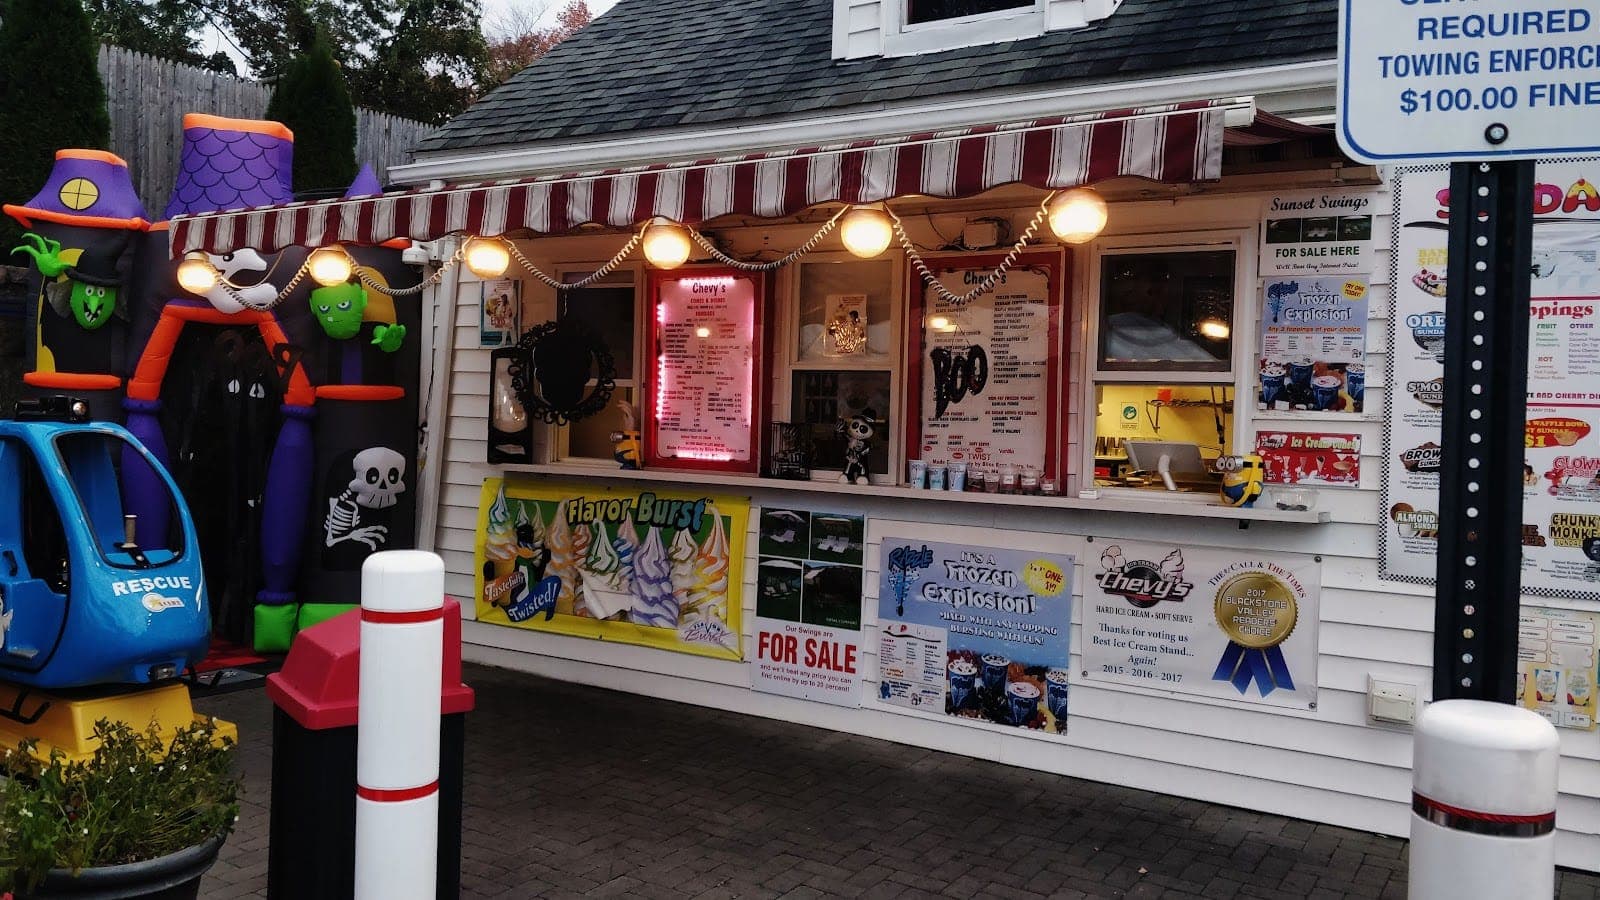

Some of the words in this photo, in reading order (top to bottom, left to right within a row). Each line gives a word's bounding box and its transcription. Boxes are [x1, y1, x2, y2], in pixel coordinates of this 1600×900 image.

[1417, 9, 1591, 41] REQUIRED
[1378, 50, 1480, 79] TOWING
[1400, 88, 1518, 116] $100.00
[1528, 82, 1600, 107] FINE
[1271, 197, 1315, 212] Sunset
[1320, 195, 1368, 211] Swings
[1275, 248, 1297, 258] FOR
[1300, 247, 1327, 257] SALE
[1330, 246, 1360, 256] HERE
[692, 282, 726, 296] Chevy's
[1298, 292, 1343, 305] Frozen
[1285, 307, 1353, 322] Explosion!
[1290, 436, 1303, 448] Ice
[568, 496, 633, 526] Flavor
[637, 491, 707, 532] Burst
[1396, 511, 1435, 524] ALMOND
[961, 551, 984, 564] IT'S
[986, 554, 997, 565] A
[944, 559, 1018, 589] Frozen
[1267, 561, 1286, 577] THE
[1286, 572, 1307, 599] TIMES
[112, 576, 192, 597] RESCUE
[484, 571, 525, 601] Tastefully
[1100, 571, 1194, 600] Chevy's
[1246, 588, 1266, 598] 2017
[507, 582, 558, 621] Twisted!
[922, 582, 1037, 615] Explosion!
[1226, 596, 1288, 609] BLACKSTONE
[1096, 605, 1114, 614] HARD
[1115, 607, 1126, 615] ICE
[1127, 609, 1150, 619] CREAM
[1155, 612, 1172, 621] SOFT
[1172, 613, 1193, 623] SERVE
[1237, 606, 1275, 617] VALLEY
[785, 625, 797, 633] Our
[798, 626, 822, 638] Swings
[950, 624, 995, 639] BURSTING
[996, 630, 1021, 642] WITH
[1023, 634, 1046, 646] FUN!
[969, 615, 992, 627] WITH
[995, 619, 1014, 629] ANY
[1016, 622, 1058, 636] TOPPING
[1098, 622, 1130, 635] Thanks
[1132, 626, 1146, 637] for
[1147, 630, 1176, 644] voting
[1178, 634, 1189, 642] us
[1238, 625, 1272, 637] CHOICE
[758, 631, 798, 665] FOR
[804, 638, 857, 674] SALE
[1093, 636, 1111, 647] Best
[1113, 639, 1126, 648] Ice
[1128, 640, 1158, 653] Cream
[1159, 644, 1195, 657] Stand...
[1128, 654, 1158, 666] Again!
[800, 670, 810, 678] any
[1103, 664, 1124, 675] 2015
[1131, 668, 1153, 679] 2016
[1161, 672, 1183, 683] 2017
